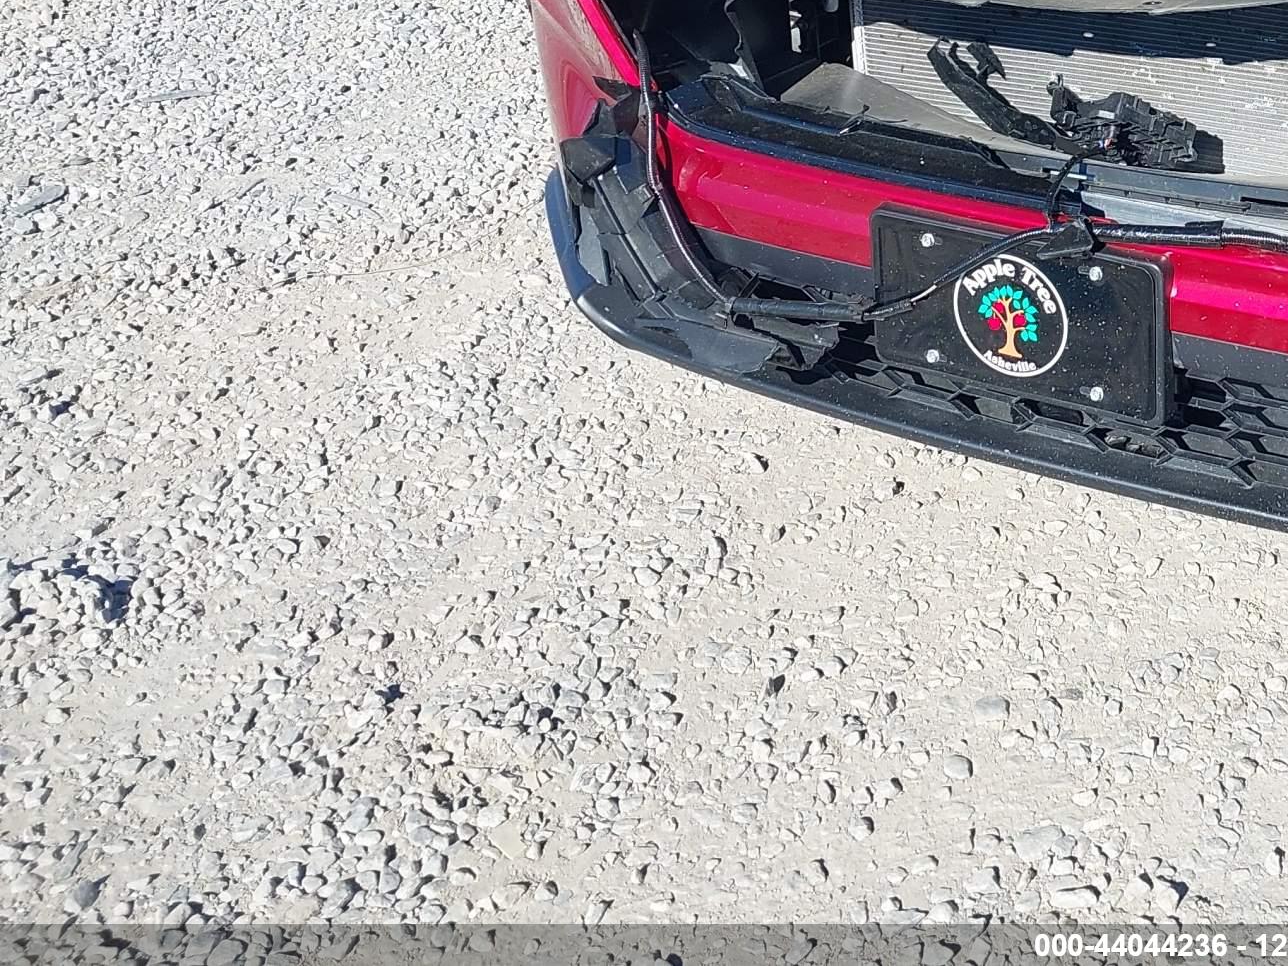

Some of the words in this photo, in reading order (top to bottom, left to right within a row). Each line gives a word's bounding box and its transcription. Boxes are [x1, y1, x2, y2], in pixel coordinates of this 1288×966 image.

[962, 258, 1016, 297] Apple
[1020, 266, 1057, 315] Tree
[983, 349, 1037, 372] Asheville
